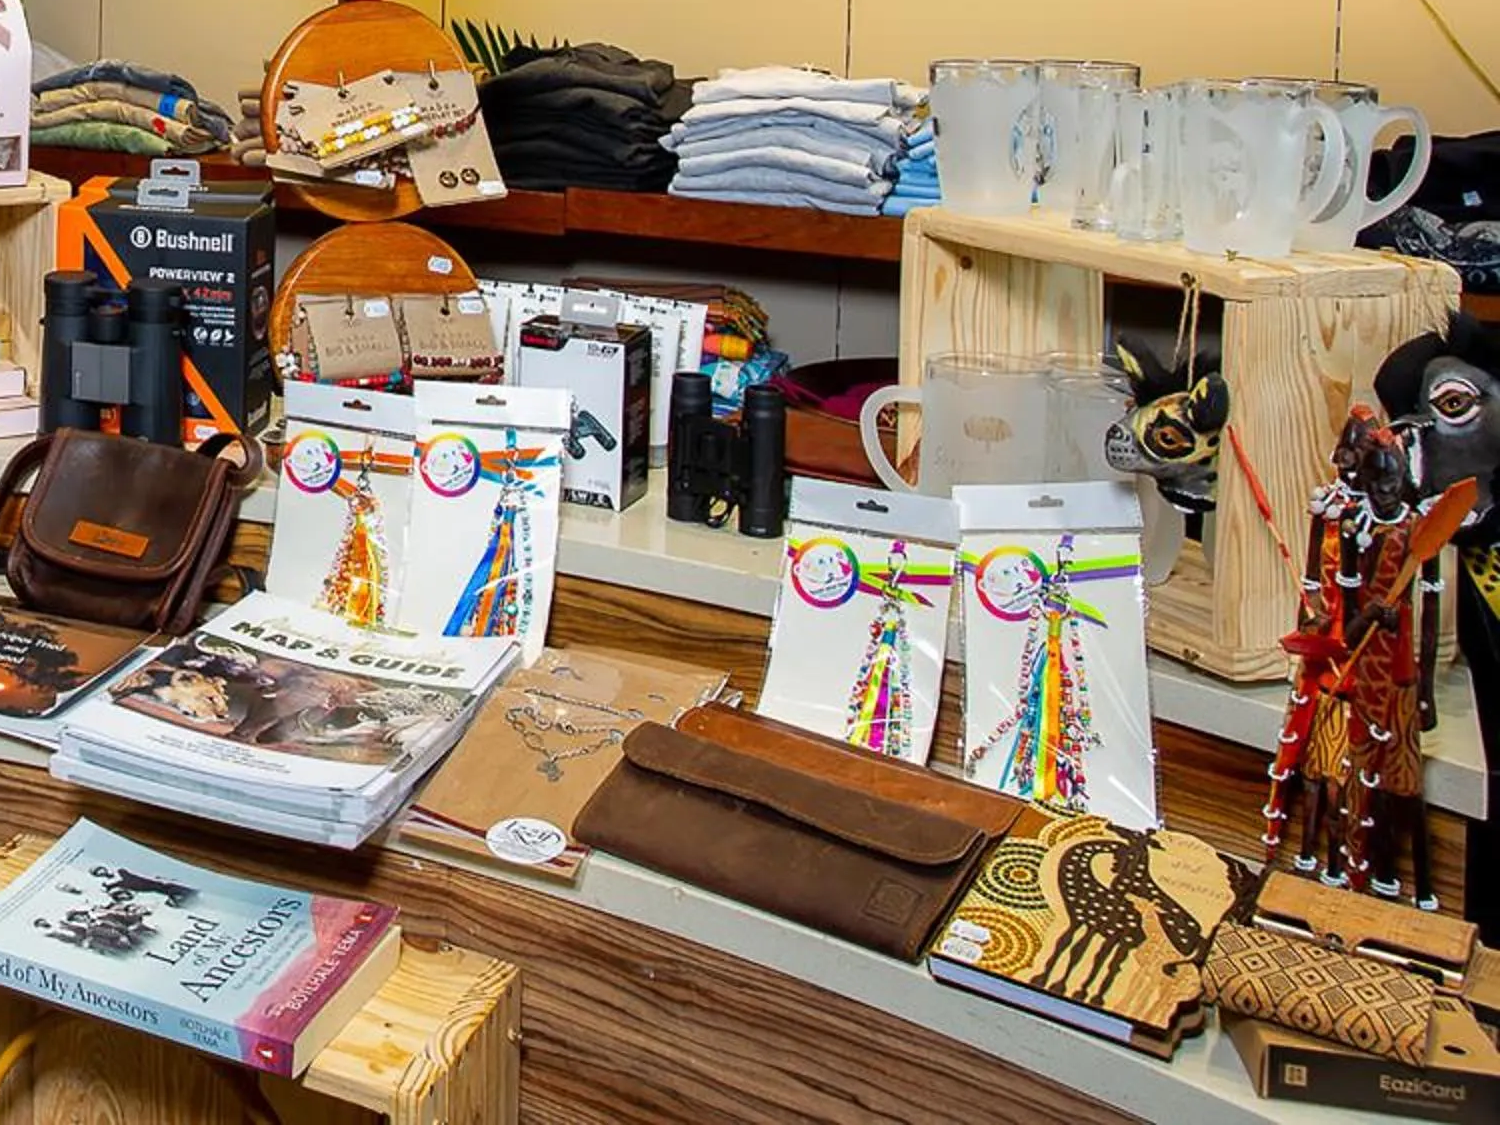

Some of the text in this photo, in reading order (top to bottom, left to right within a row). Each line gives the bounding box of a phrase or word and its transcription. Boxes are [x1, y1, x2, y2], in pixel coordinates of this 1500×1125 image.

[156, 229, 233, 252] Bushnell
[3, 644, 29, 654] and
[230, 621, 315, 651] MAP
[316, 647, 341, 660] &
[348, 653, 466, 680] GUIDE
[146, 914, 220, 966] Land
[180, 896, 303, 1003] Ancestors
[14, 965, 35, 984] of
[38, 969, 67, 1000] My
[71, 981, 159, 1026] Ancestors
[1379, 1074, 1467, 1101] EaziCard
